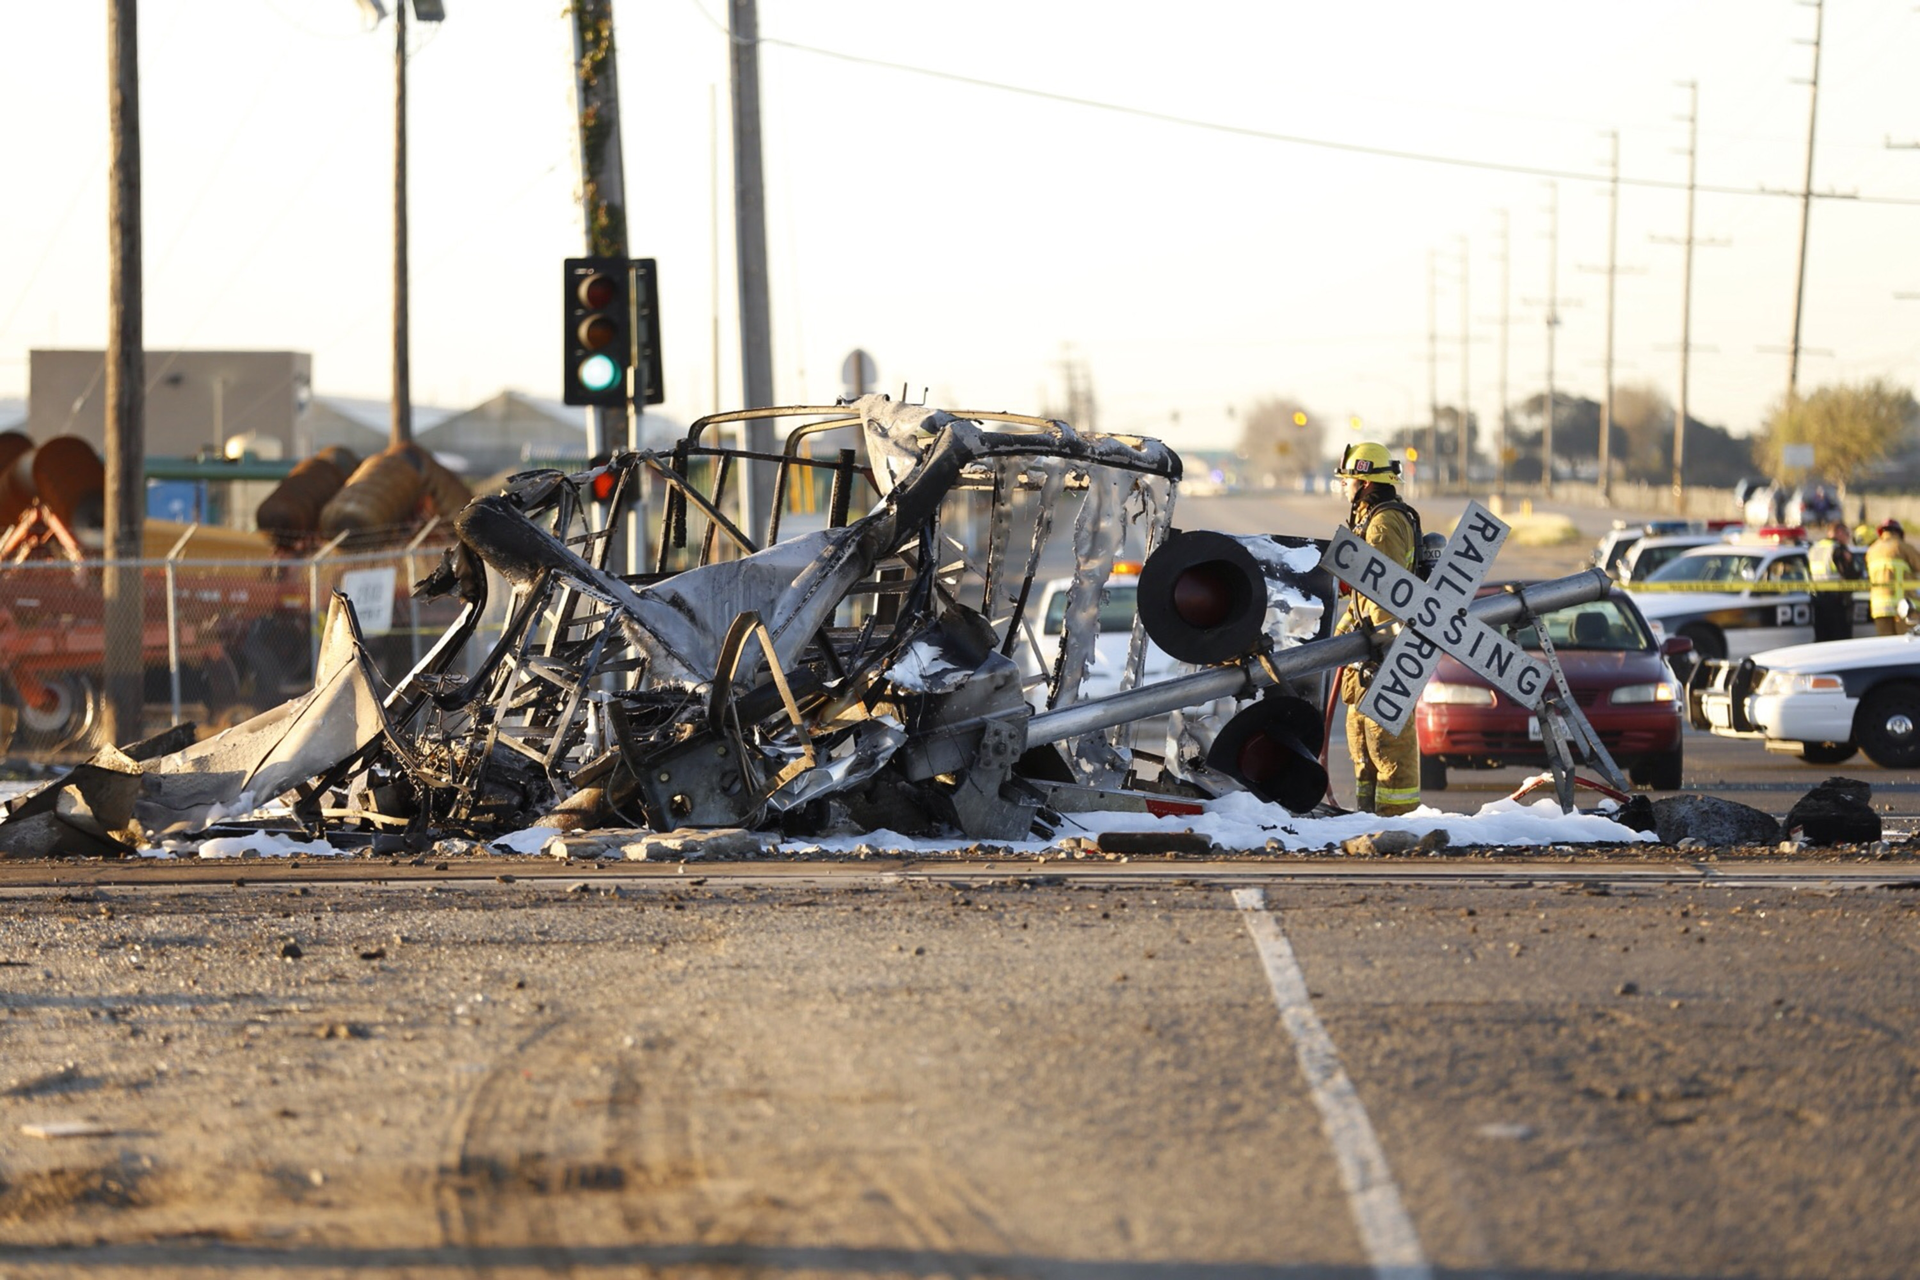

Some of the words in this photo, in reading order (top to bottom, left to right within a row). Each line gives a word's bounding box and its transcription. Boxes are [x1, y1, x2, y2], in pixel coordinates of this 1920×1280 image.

[1356, 460, 1370, 472] 61
[1434, 511, 1501, 596] RAIL
[1334, 539, 1541, 696] CROSSING
[1373, 636, 1437, 722] ROAD
